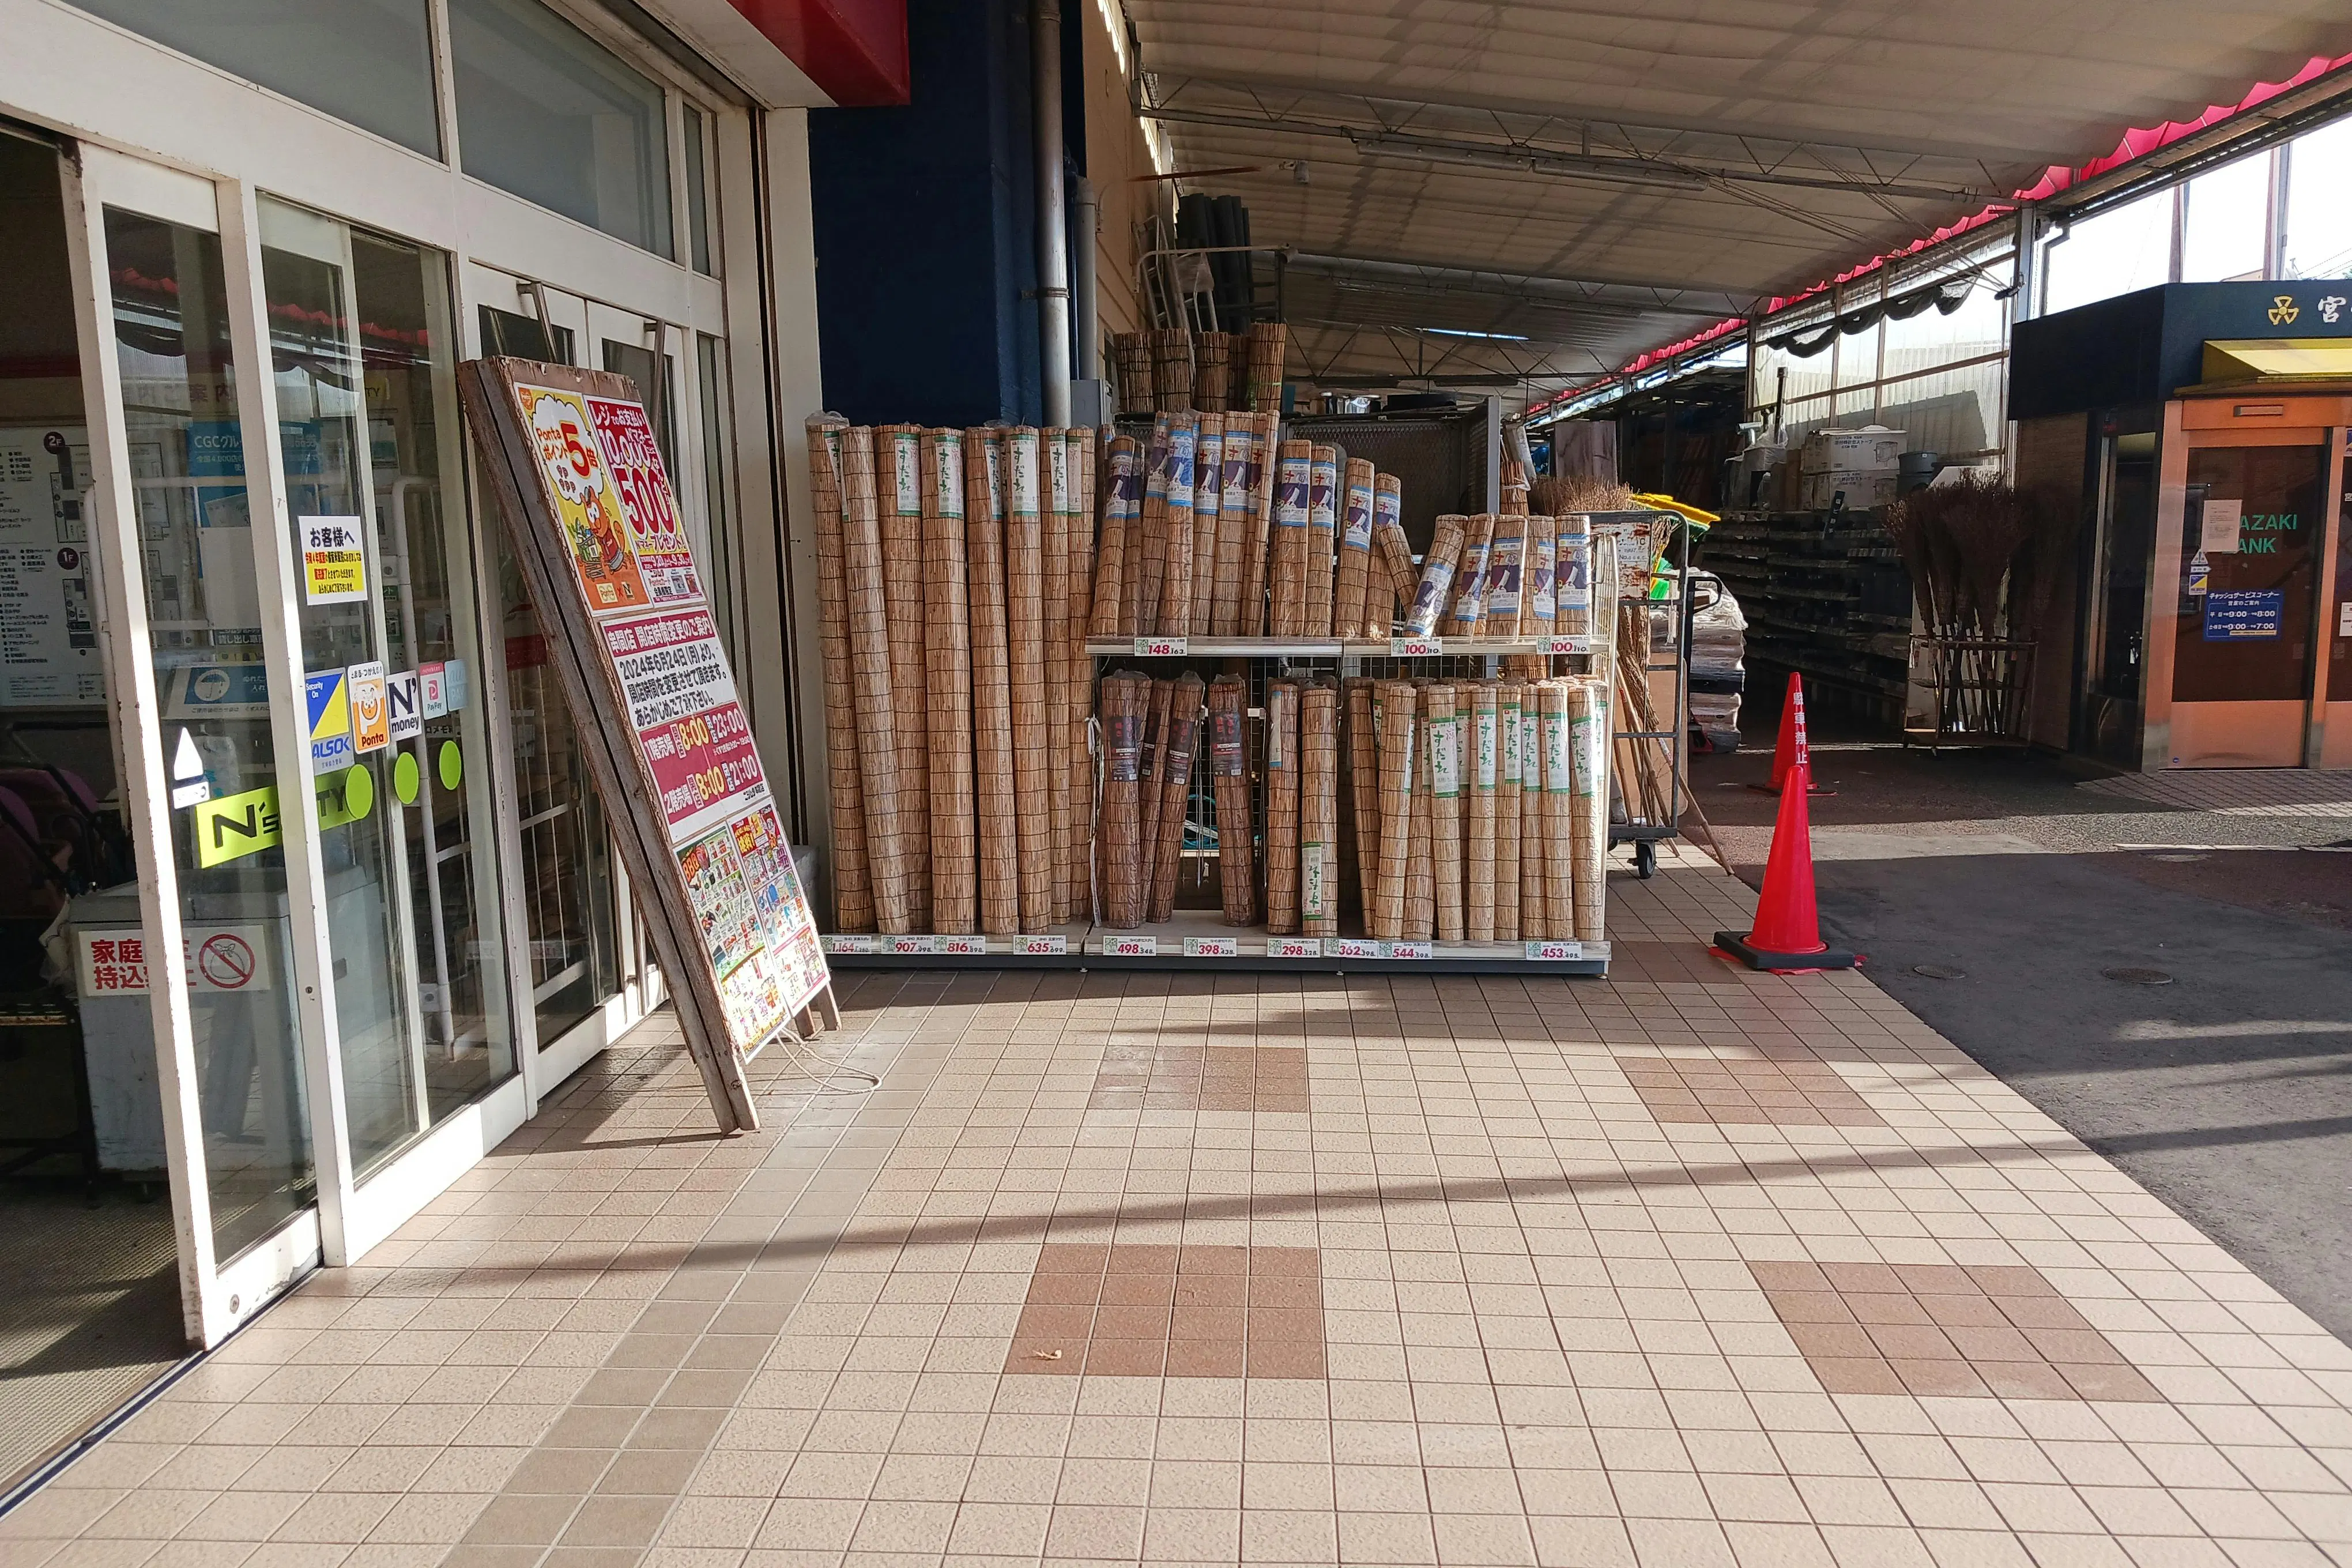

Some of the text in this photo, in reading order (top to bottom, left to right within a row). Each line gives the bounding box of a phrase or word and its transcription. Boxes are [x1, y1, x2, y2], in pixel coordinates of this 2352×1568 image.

[2317, 296, 2352, 323] 宮
[49, 435, 62, 446] 2F
[194, 435, 242, 448] CGCグル
[536, 427, 561, 443] Ponta
[543, 444, 568, 461] ポイント
[898, 446, 912, 492] すだれ
[938, 448, 953, 493] すだれ
[1013, 447, 1027, 493] すだれ
[1053, 447, 1066, 493] すだれ
[615, 467, 676, 536] 500
[2239, 514, 2297, 530] AZAKI
[310, 526, 355, 548] お客様へ
[2237, 537, 2276, 553] ANK
[63, 552, 74, 562] 1F
[2209, 591, 2279, 600] キャッシュサービスコーナー
[1148, 644, 1170, 654] 148
[1405, 644, 1426, 654] 100
[1551, 642, 1573, 652] 100
[306, 681, 323, 691] Security
[427, 702, 442, 711] PayPay
[391, 716, 420, 734] money
[679, 717, 710, 751] 8:00
[711, 708, 744, 739] 23:00
[361, 733, 384, 747] Ponta
[1479, 721, 1493, 767] すだれ
[1505, 716, 1518, 760] すだれ
[1522, 723, 1538, 768] すだれ
[312, 736, 351, 759] ALSOK
[1433, 731, 1449, 774] すだれ
[1548, 725, 1562, 770] すだれ
[695, 766, 725, 801] 8:00
[729, 754, 758, 786] 21:00
[683, 851, 700, 883] BBQ
[832, 943, 854, 952] 1,164
[895, 943, 917, 952] 907
[947, 943, 969, 952] 816
[1028, 943, 1049, 952] 635
[1118, 944, 1139, 953] 498
[1198, 945, 1219, 954] 398
[1281, 945, 1303, 955] 298
[1338, 945, 1360, 956] 362
[1392, 948, 1414, 958] 544
[1541, 948, 1563, 958] 453
[93, 965, 149, 990] 持込
